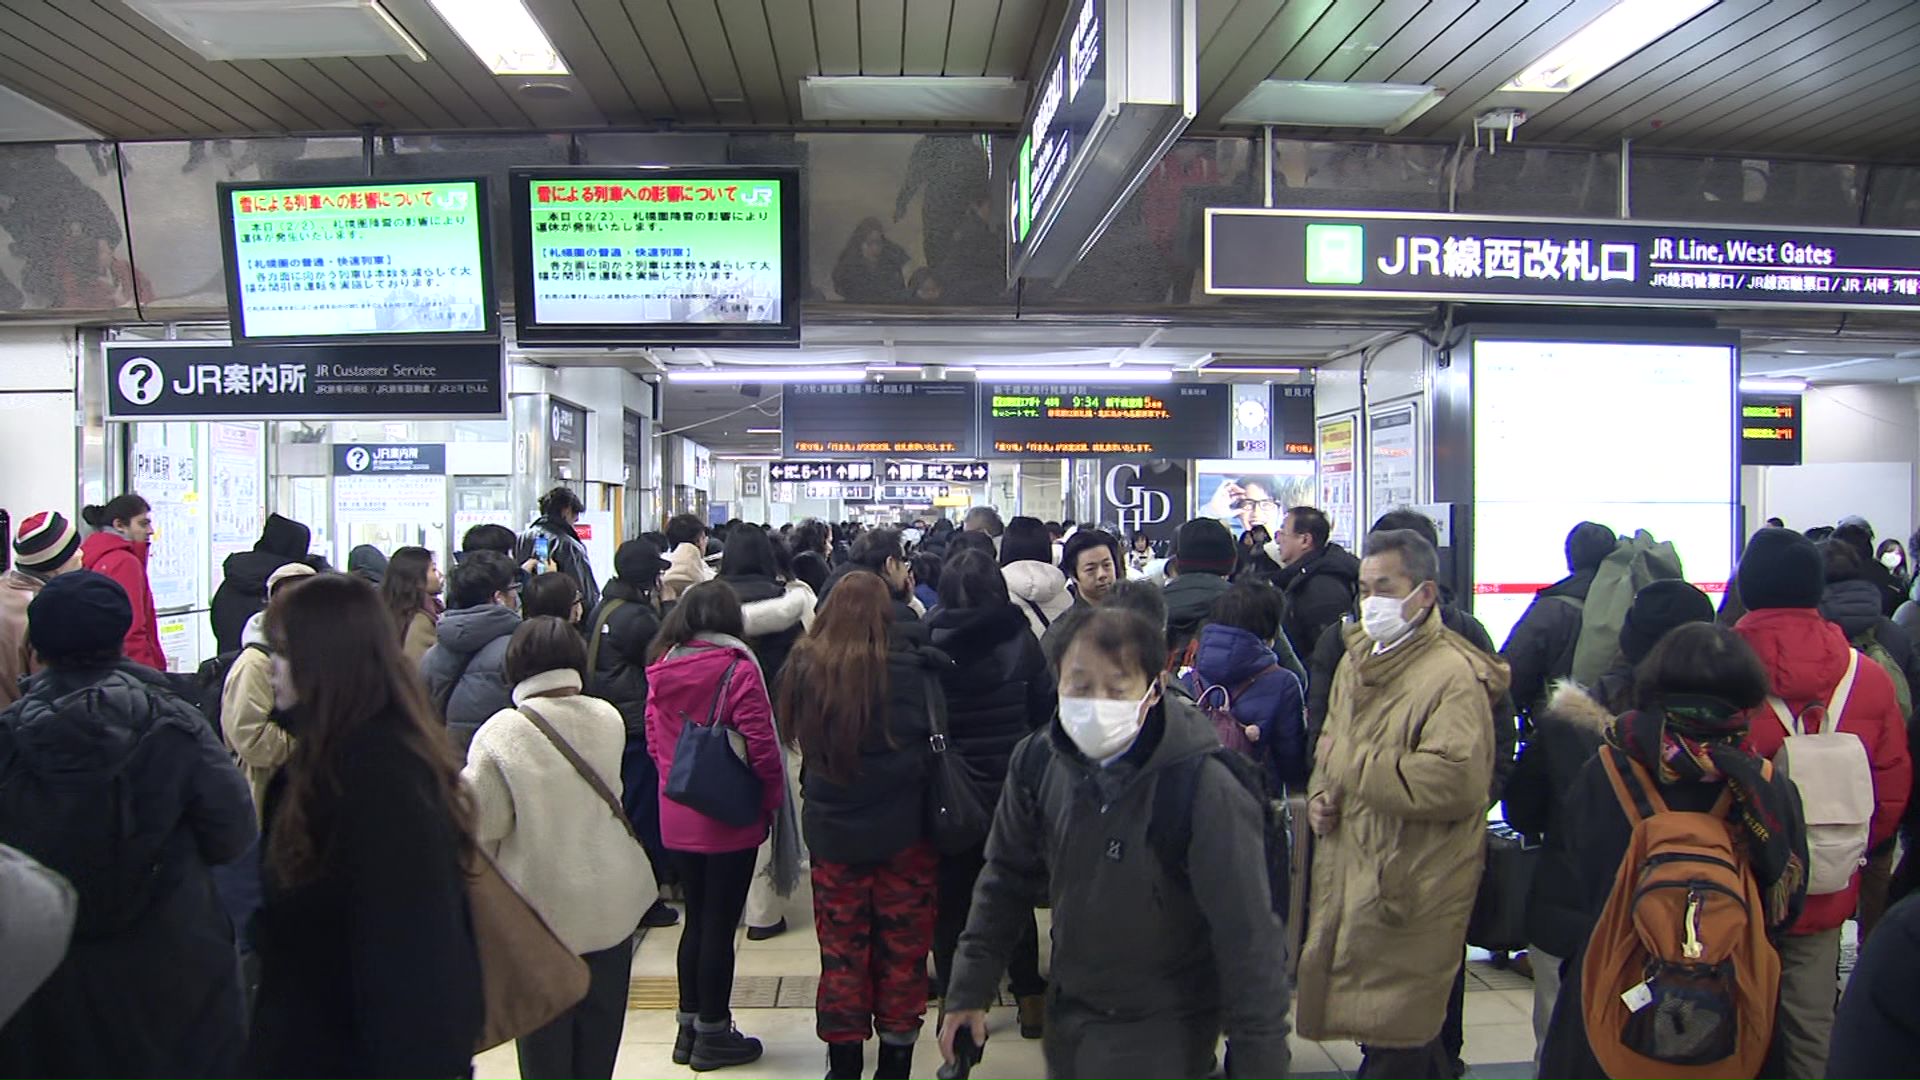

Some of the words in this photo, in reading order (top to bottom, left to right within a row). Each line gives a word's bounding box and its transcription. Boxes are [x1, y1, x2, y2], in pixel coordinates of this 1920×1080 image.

[240, 190, 433, 213] 雪による列車への影響について
[538, 186, 737, 203] 雪による列車への影響について
[741, 186, 772, 206] JR
[1378, 237, 1636, 283] JR線西改札口
[1650, 238, 1673, 260] JR
[1679, 239, 1724, 263] Line,
[1726, 240, 1774, 263] West
[1780, 242, 1834, 265] Gates
[1893, 277, 1920, 295] 개찰
[173, 363, 306, 395] JR案内所
[315, 364, 329, 377] JR
[333, 364, 388, 377] Customer
[393, 364, 437, 377] Service
[1073, 396, 1099, 408] 9:34
